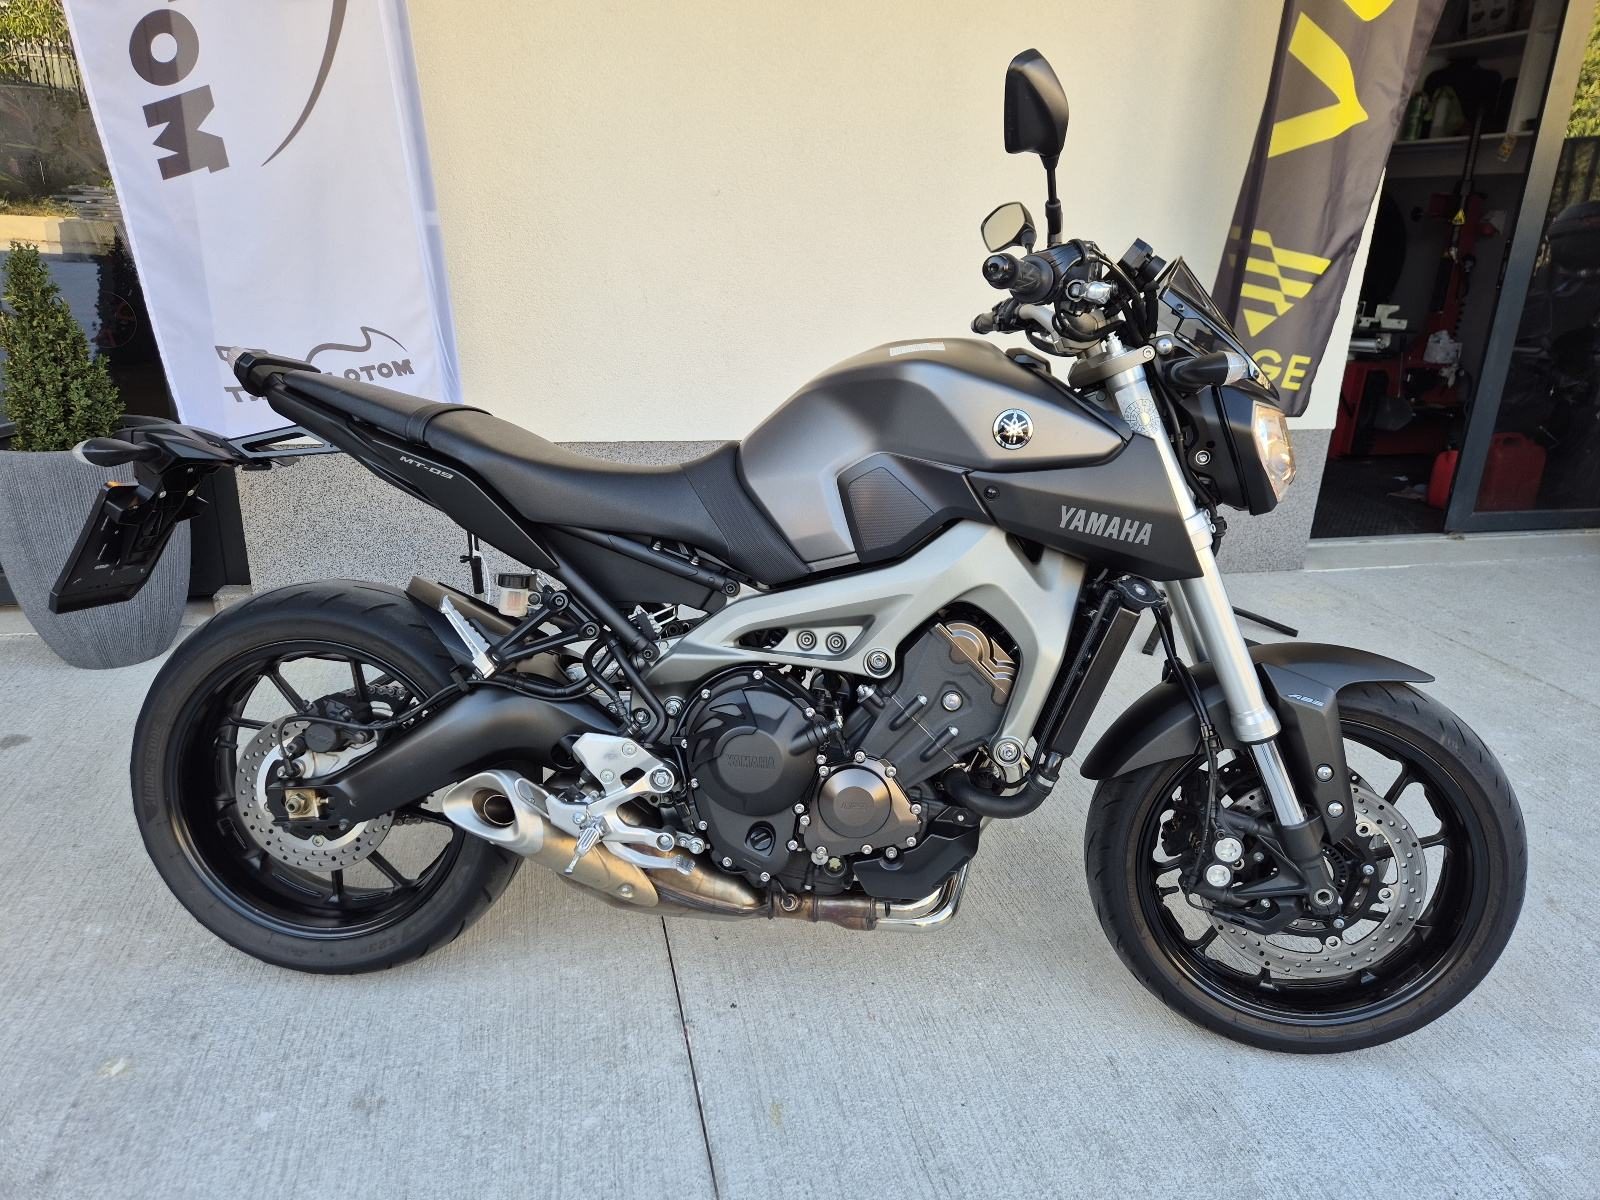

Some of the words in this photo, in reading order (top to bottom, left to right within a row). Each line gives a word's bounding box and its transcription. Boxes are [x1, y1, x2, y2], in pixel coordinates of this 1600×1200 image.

[1252, 348, 1312, 391] GE
[399, 455, 454, 480] MT-09
[1059, 504, 1153, 546] YAMAHA
[727, 754, 776, 769] YAMAHA
